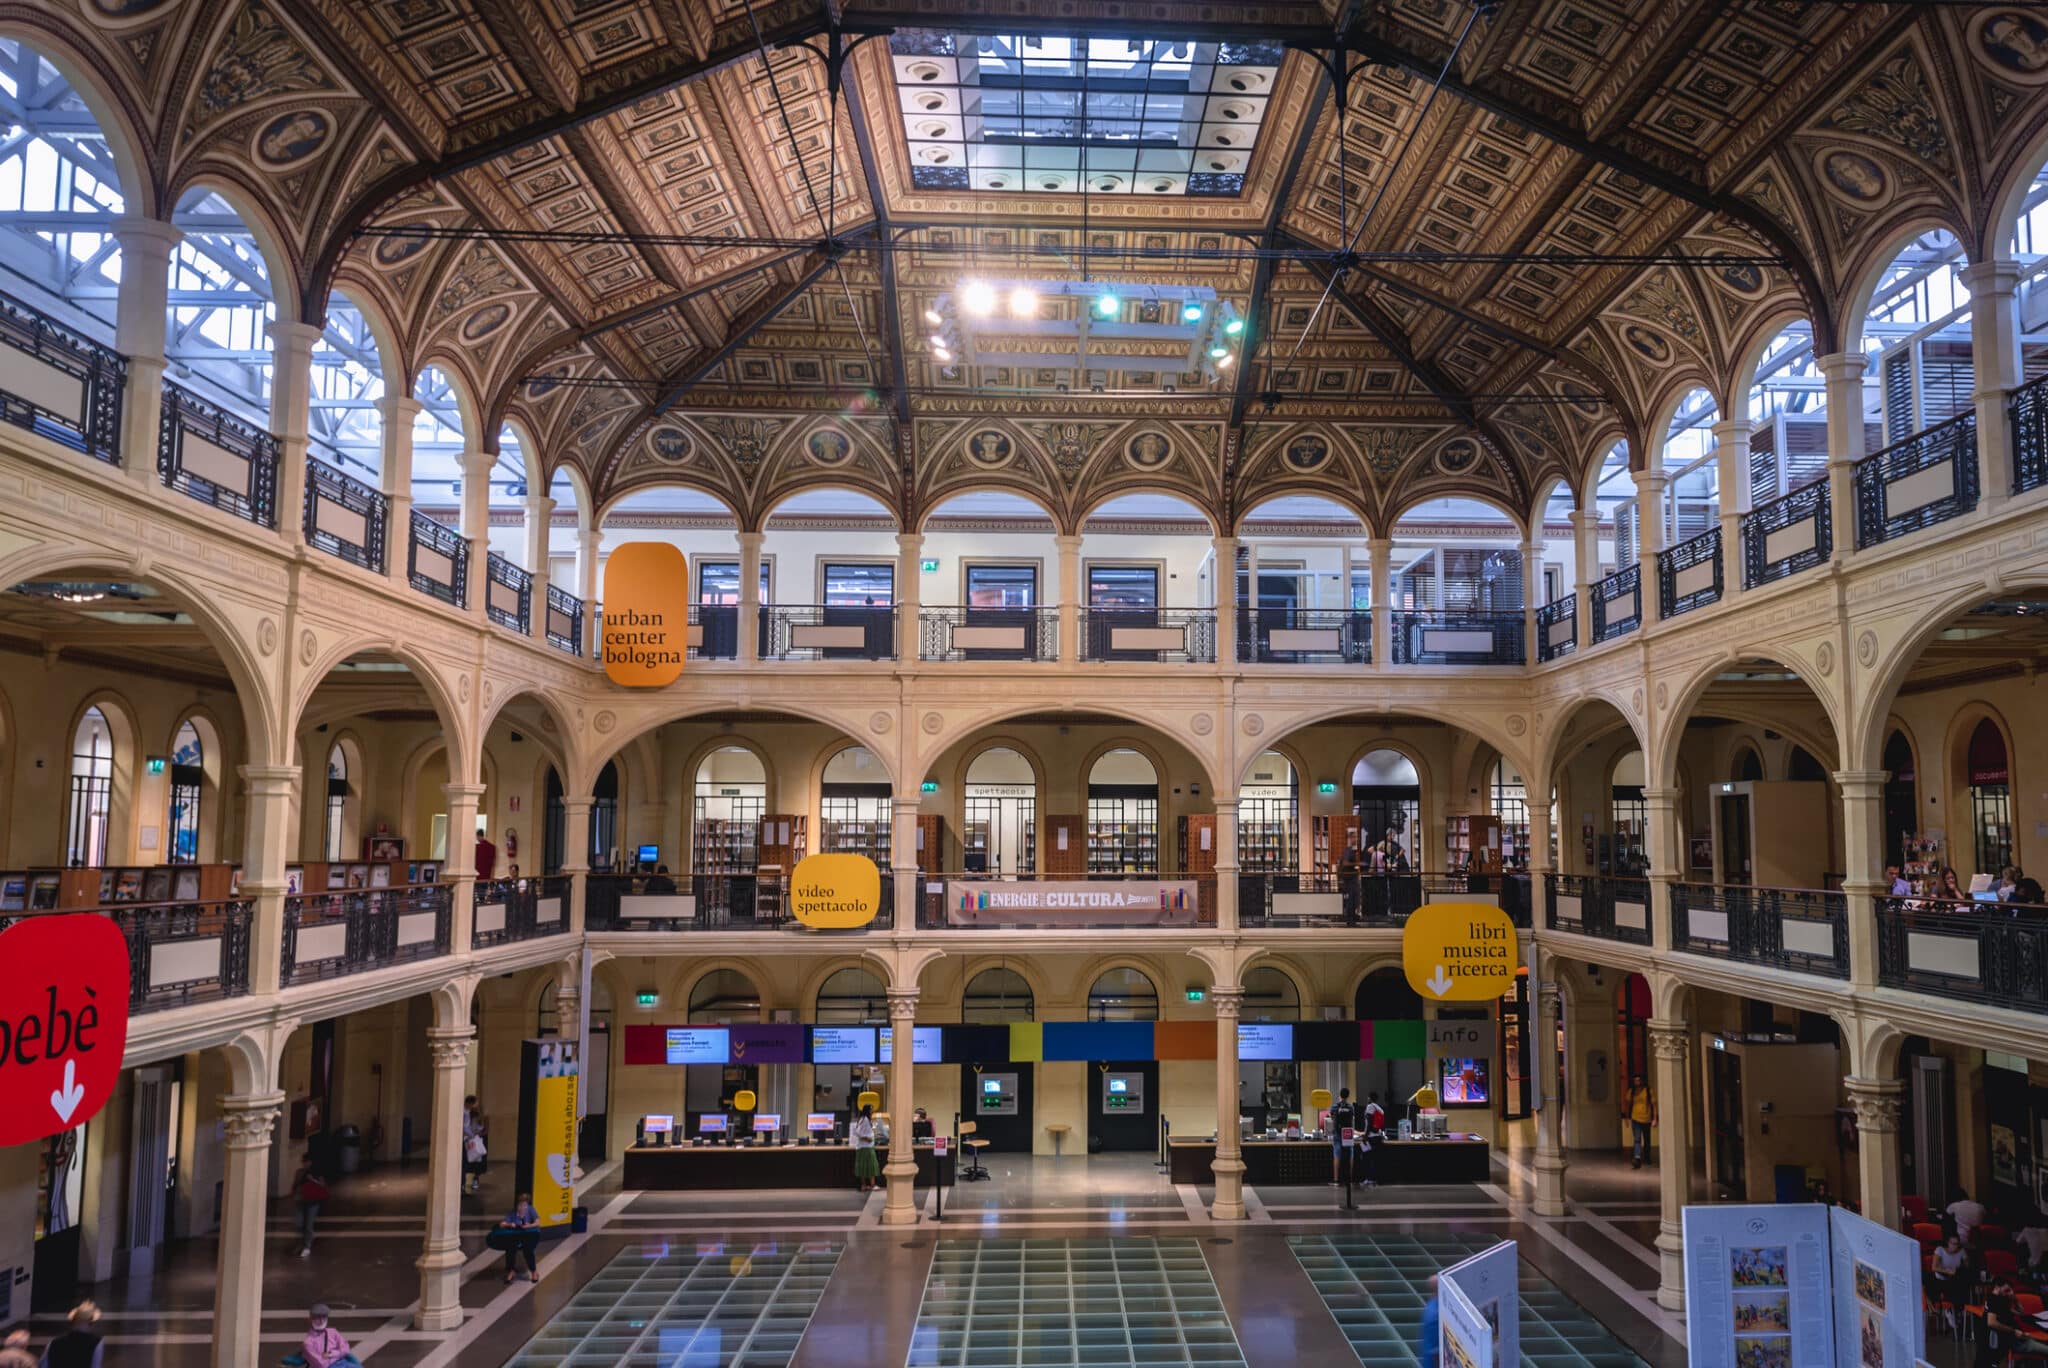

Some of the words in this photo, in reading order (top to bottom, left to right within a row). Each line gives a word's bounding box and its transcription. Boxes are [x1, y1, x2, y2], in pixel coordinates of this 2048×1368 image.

[606, 608, 663, 626] urban
[605, 631, 666, 645] center
[606, 647, 681, 669] bologna
[798, 885, 834, 897] video
[797, 899, 867, 915] spettacolo
[989, 892, 1039, 907] ENERGIE
[1046, 892, 1125, 907] CULTURA
[1469, 922, 1506, 940] libri
[1443, 942, 1507, 958] musica
[1448, 961, 1507, 977] ricerca
[1431, 1026, 1479, 1042] info
